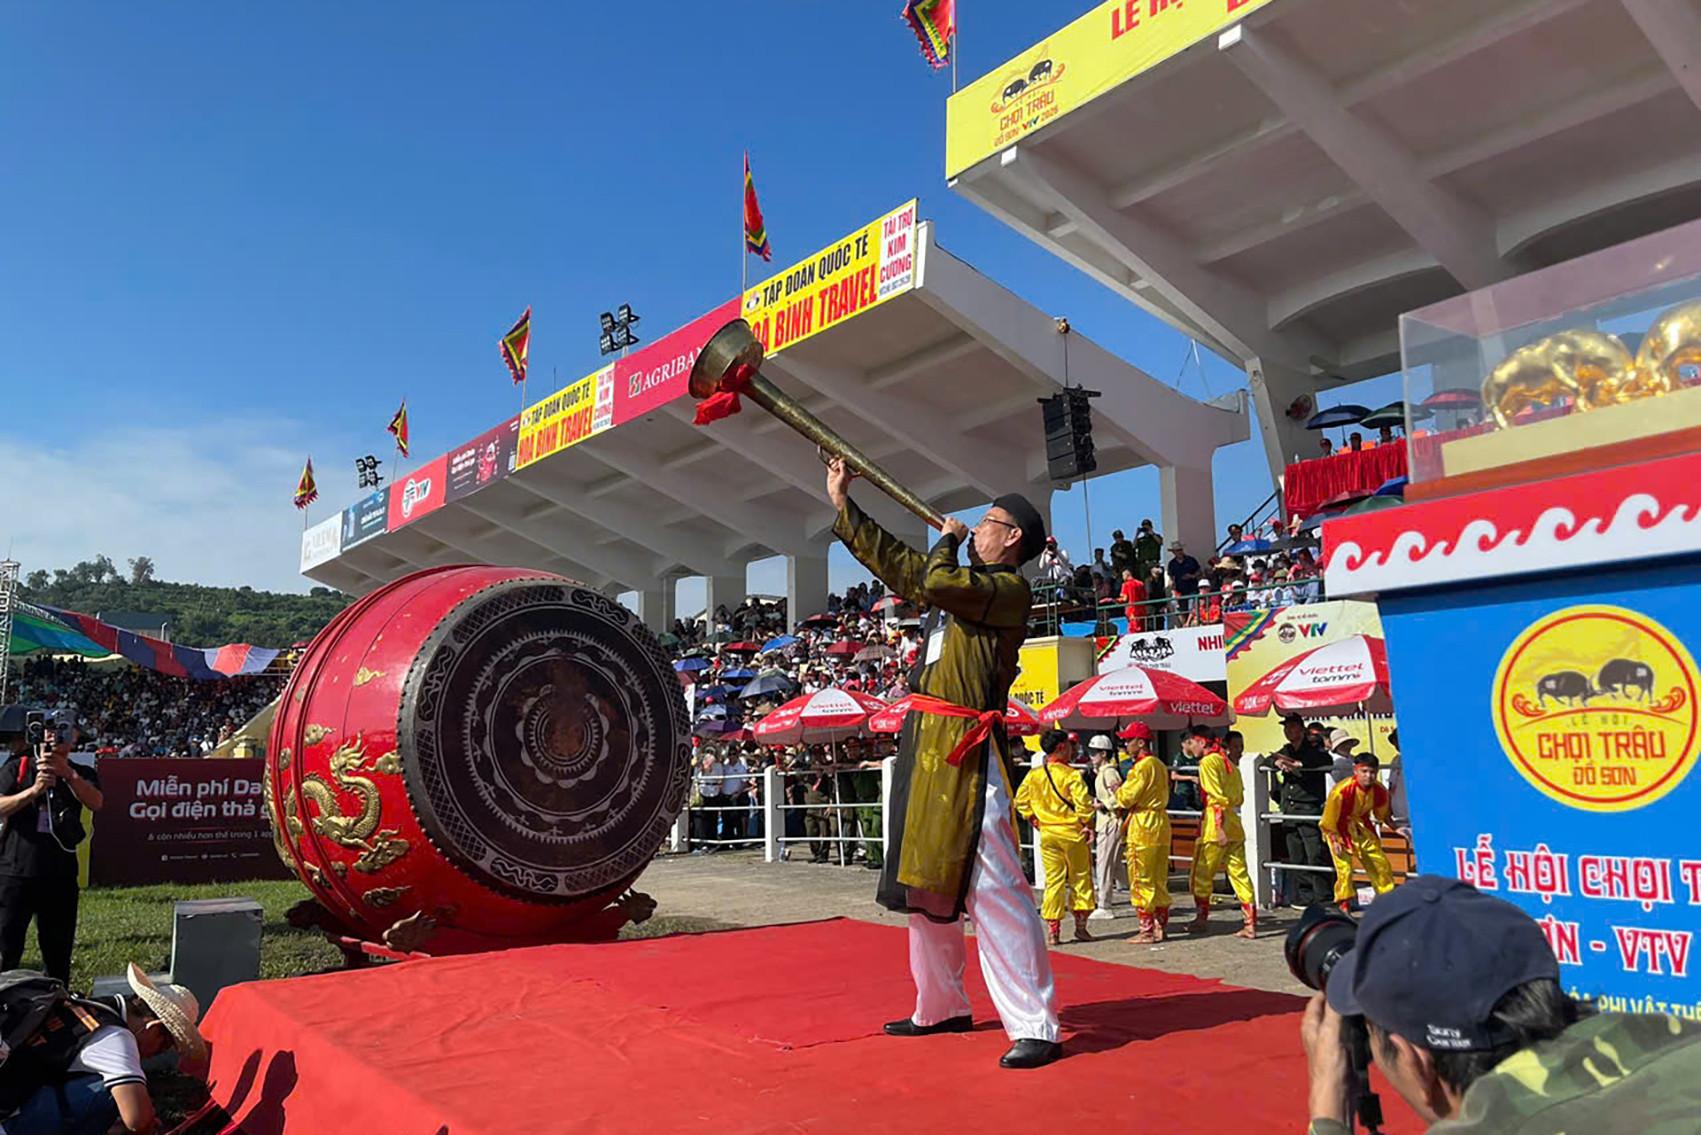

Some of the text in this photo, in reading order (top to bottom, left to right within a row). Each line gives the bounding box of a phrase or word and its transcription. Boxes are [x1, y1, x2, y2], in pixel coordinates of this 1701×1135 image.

[884, 216, 897, 239] TÀI
[888, 233, 907, 258] KIM
[763, 231, 869, 308] TẬP ĐOÀN QUỐC TẾ
[774, 295, 813, 348] BÌNH
[818, 263, 878, 328] TRAVEL
[1298, 622, 1328, 638] VTV
[1538, 725, 1666, 763] CHỌI TRÂU
[136, 775, 191, 796] Miễn
[197, 778, 228, 799] phí
[129, 803, 167, 821] Gọi
[172, 800, 217, 821] điện
[222, 799, 255, 817] thả
[1454, 834, 1498, 890] LỄ
[1504, 844, 1571, 903] HỘI
[1578, 855, 1674, 912] CHỌI
[1612, 926, 1693, 977] VTV
